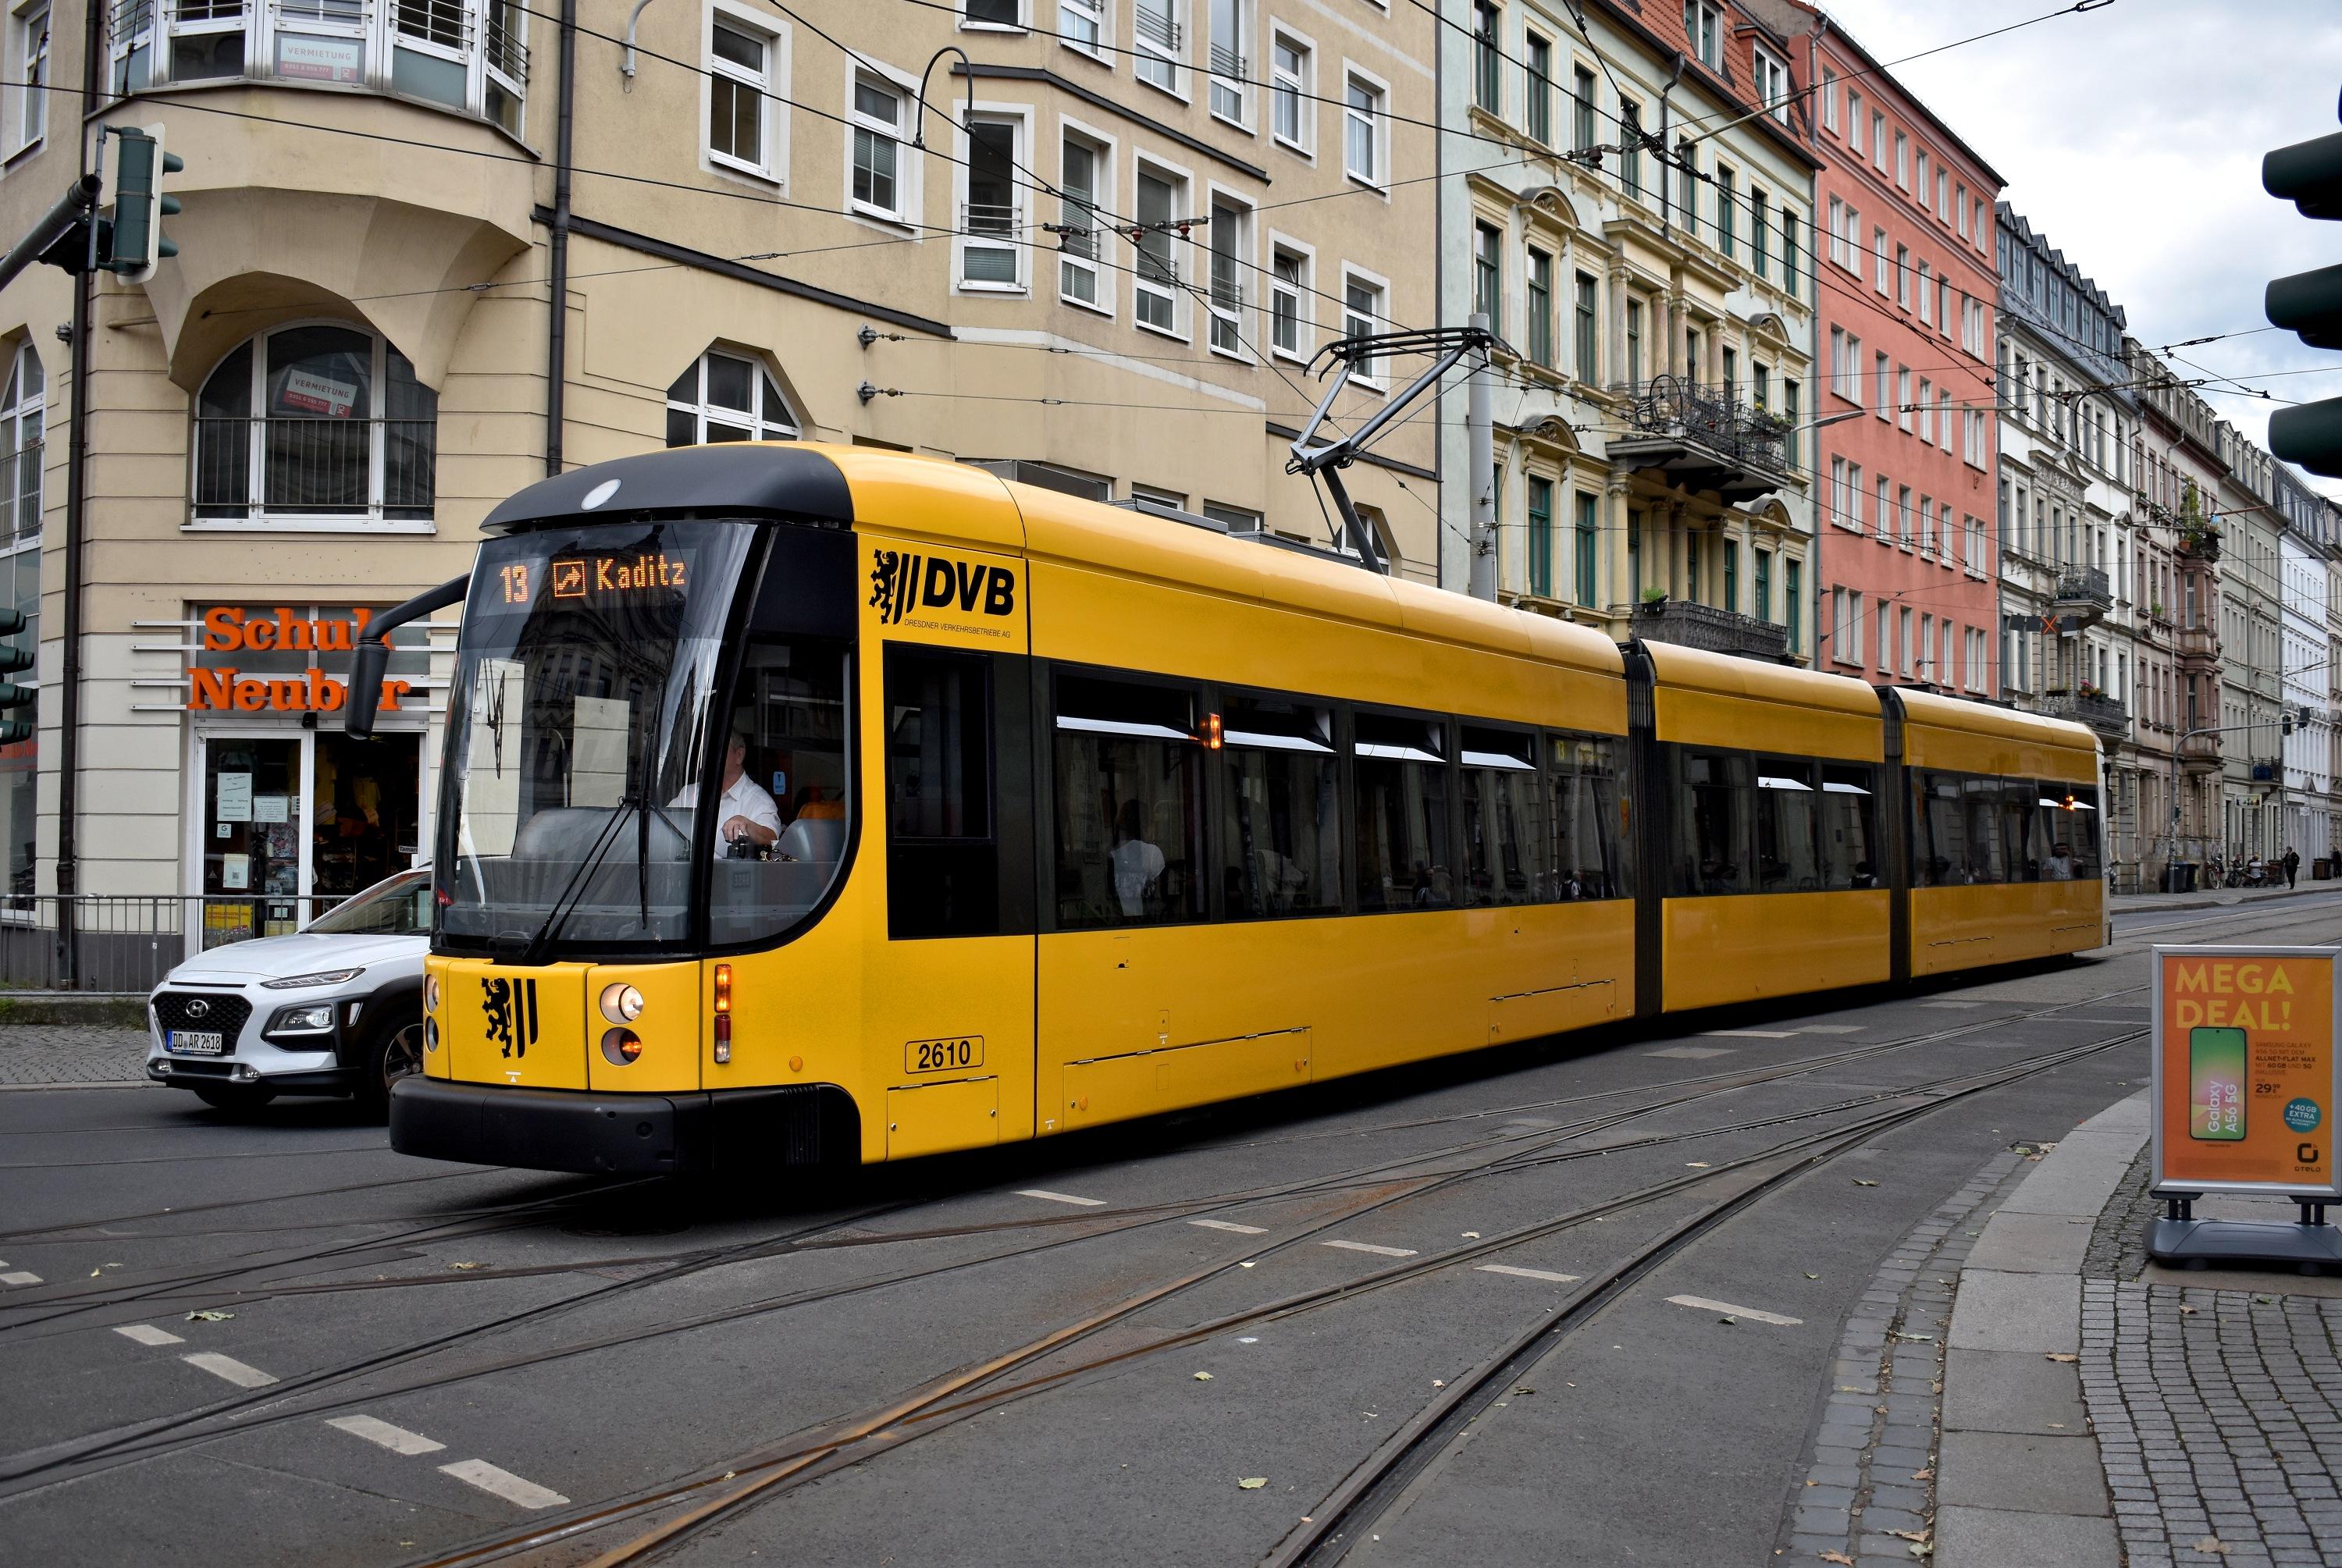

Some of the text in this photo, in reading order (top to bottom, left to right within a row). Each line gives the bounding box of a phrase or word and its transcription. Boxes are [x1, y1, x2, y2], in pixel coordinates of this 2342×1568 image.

[287, 47, 351, 60] VERMIETUNG
[295, 379, 350, 398] VERMIETUNG
[500, 555, 685, 603] 13 Kaditz
[922, 556, 1015, 617] DVB
[904, 618, 939, 630] DRESDNER
[940, 622, 1001, 638] VERKEHRSBETRIEBE
[186, 667, 411, 711] Neubr
[2175, 962, 2294, 994] MEGA
[2176, 999, 2291, 1031] DEAL!
[173, 1033, 221, 1050] DD AR 2618
[918, 1040, 970, 1068] 2610
[2255, 1083, 2272, 1093] 29
[2208, 1080, 2223, 1132] Galaxy
[2225, 1084, 2237, 1132] A56 5G
[2289, 1111, 2315, 1119] EXTRA
